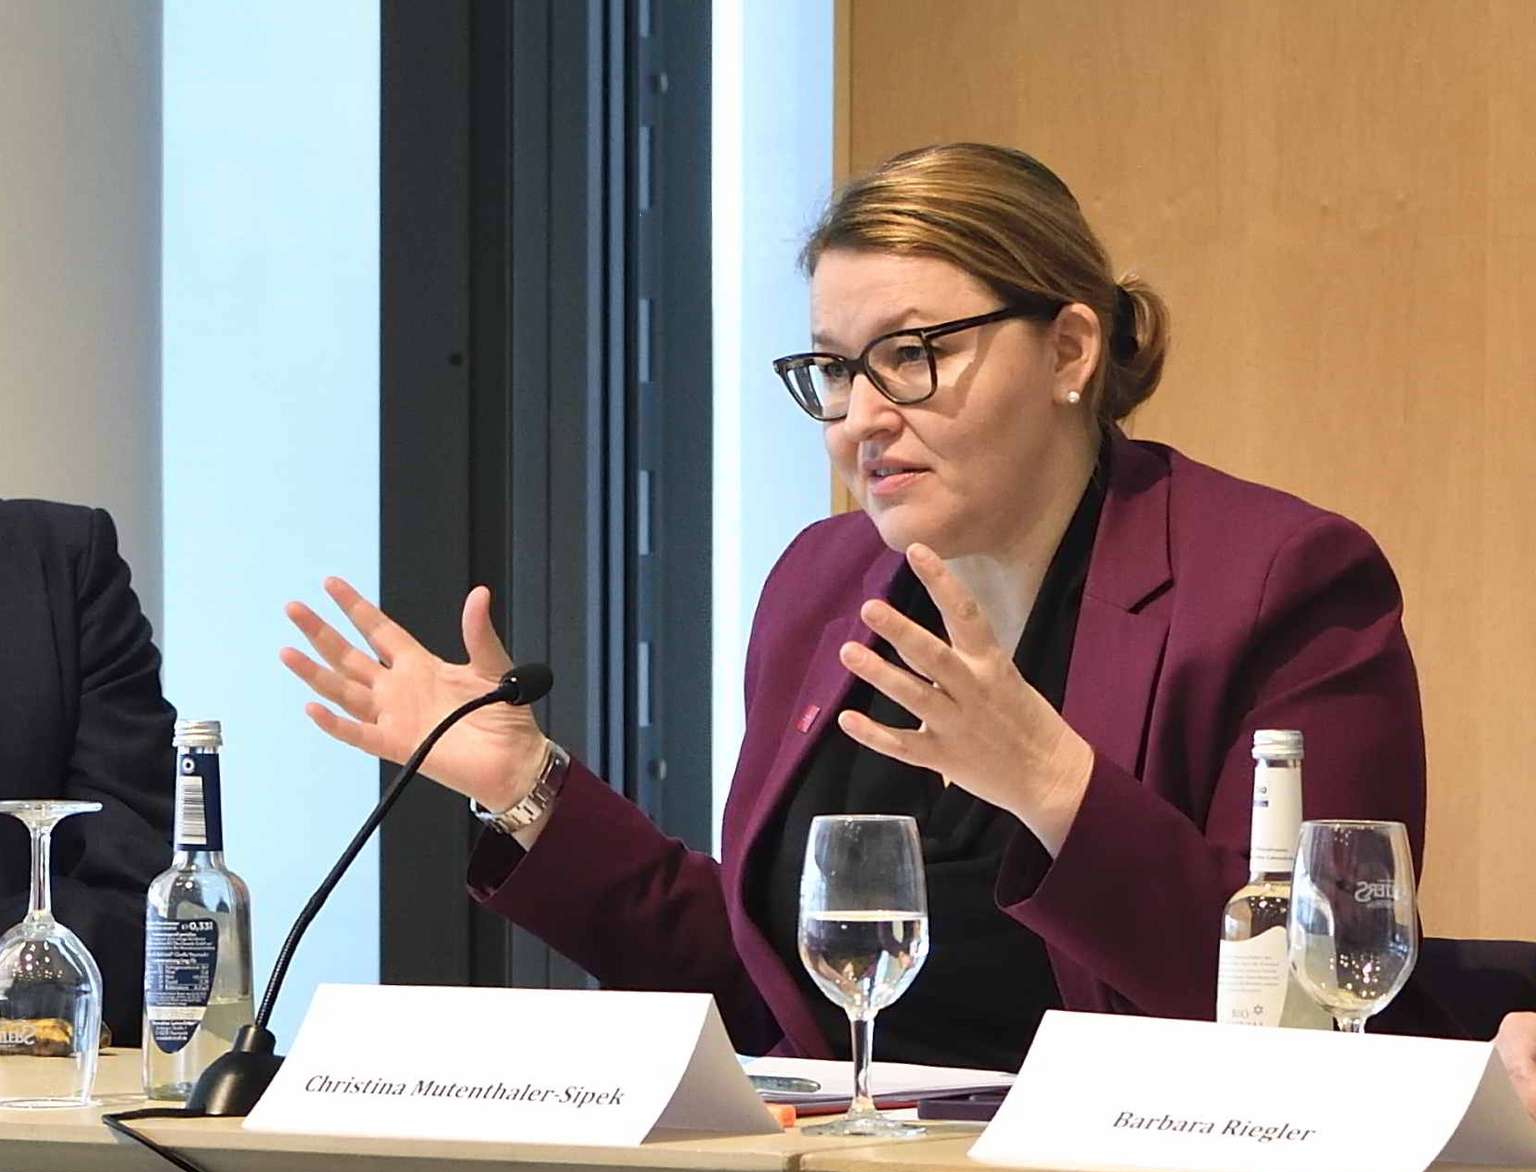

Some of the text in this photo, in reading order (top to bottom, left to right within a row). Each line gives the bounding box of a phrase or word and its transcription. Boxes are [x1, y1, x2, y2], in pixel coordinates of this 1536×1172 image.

[305, 1075, 625, 1108] Christina Mutenthaler-Sipek
[1113, 1111, 1316, 1143] Barbara Riegler
